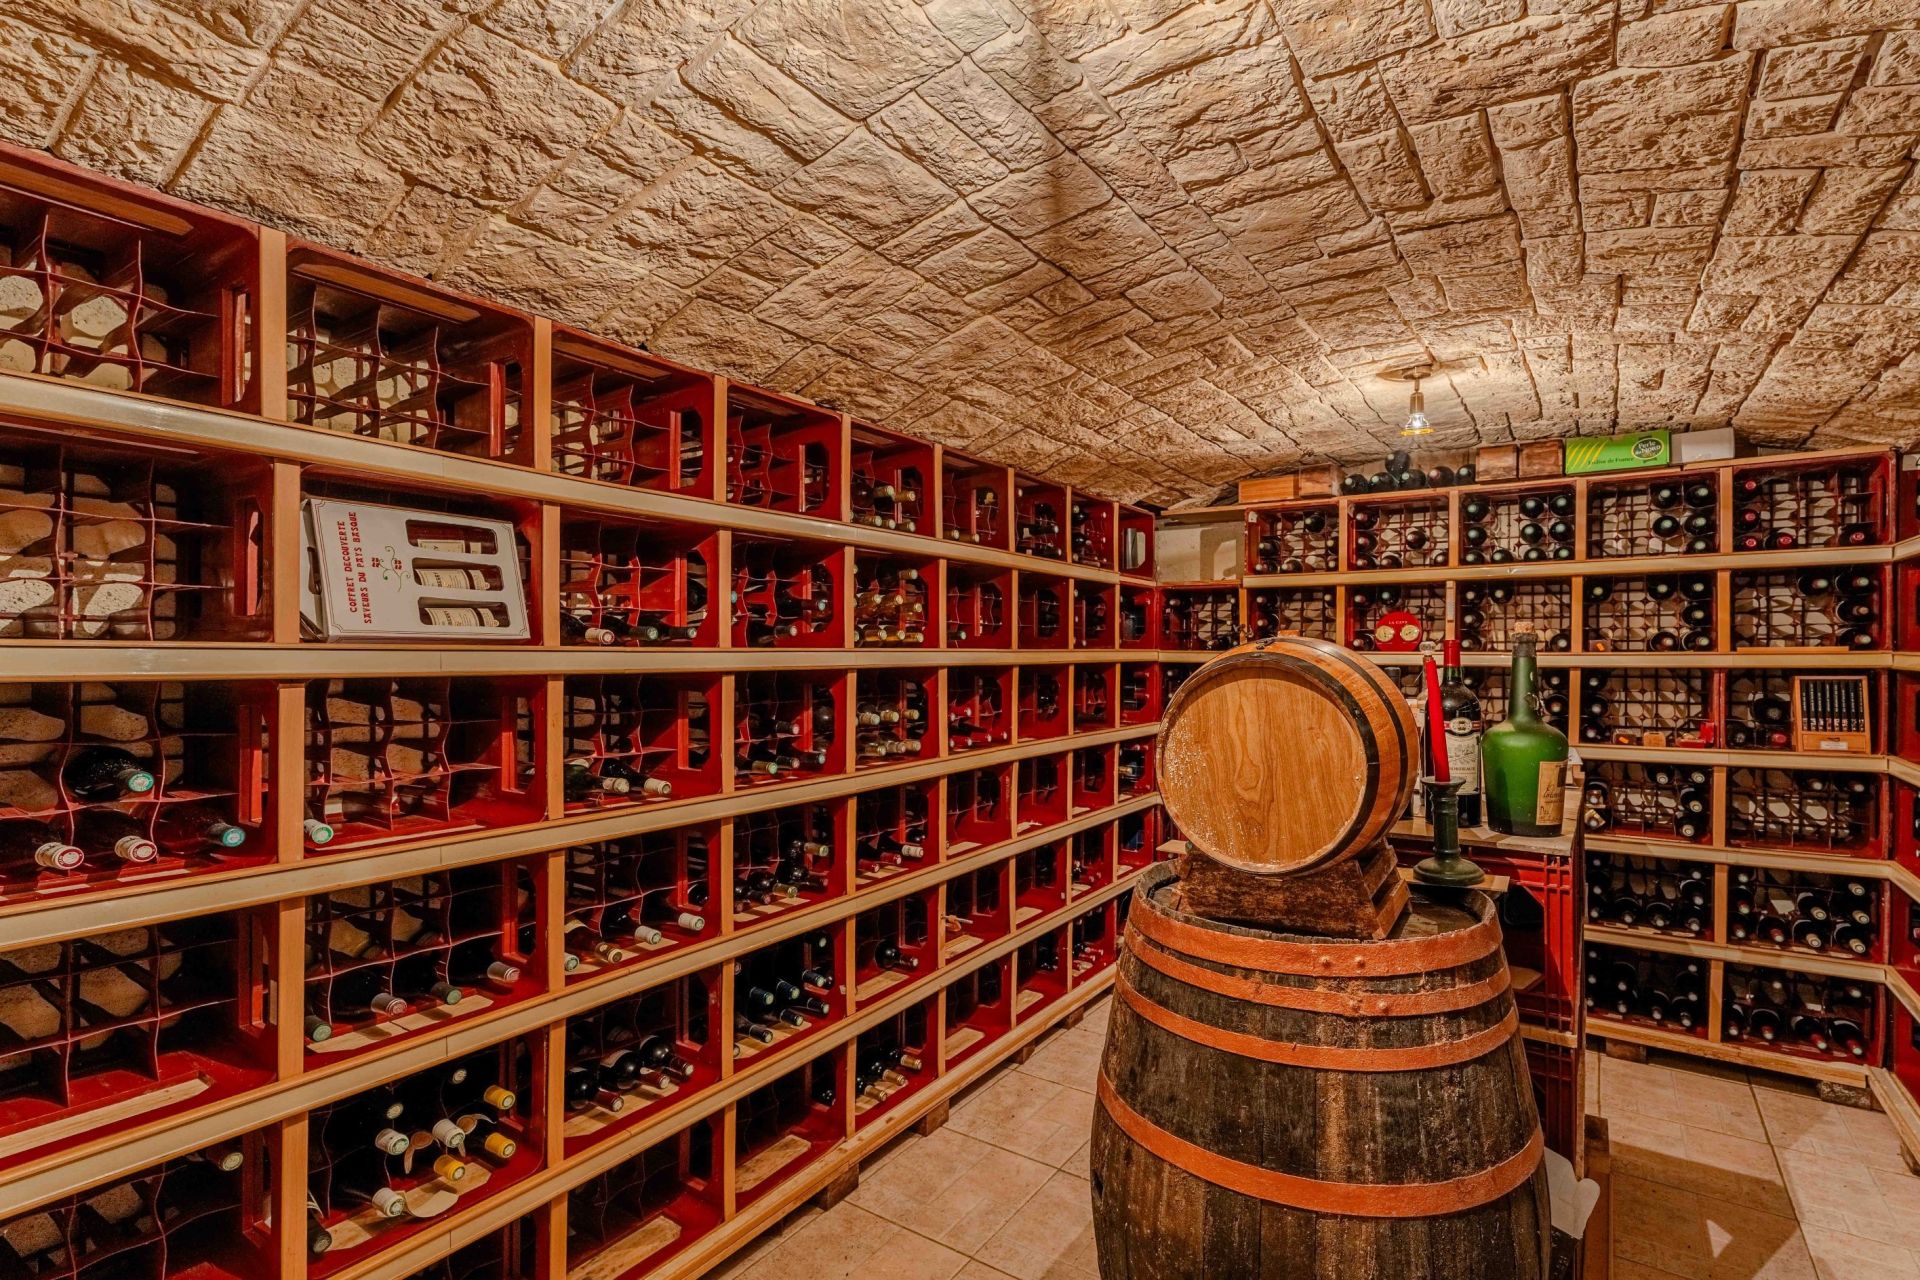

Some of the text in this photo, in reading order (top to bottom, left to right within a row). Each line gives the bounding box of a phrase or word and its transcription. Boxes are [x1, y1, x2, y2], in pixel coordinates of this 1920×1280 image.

[337, 520, 357, 612] COFFRET DECOUVERTE
[349, 511, 371, 623] SAVEURS DU PAYS BASQUE
